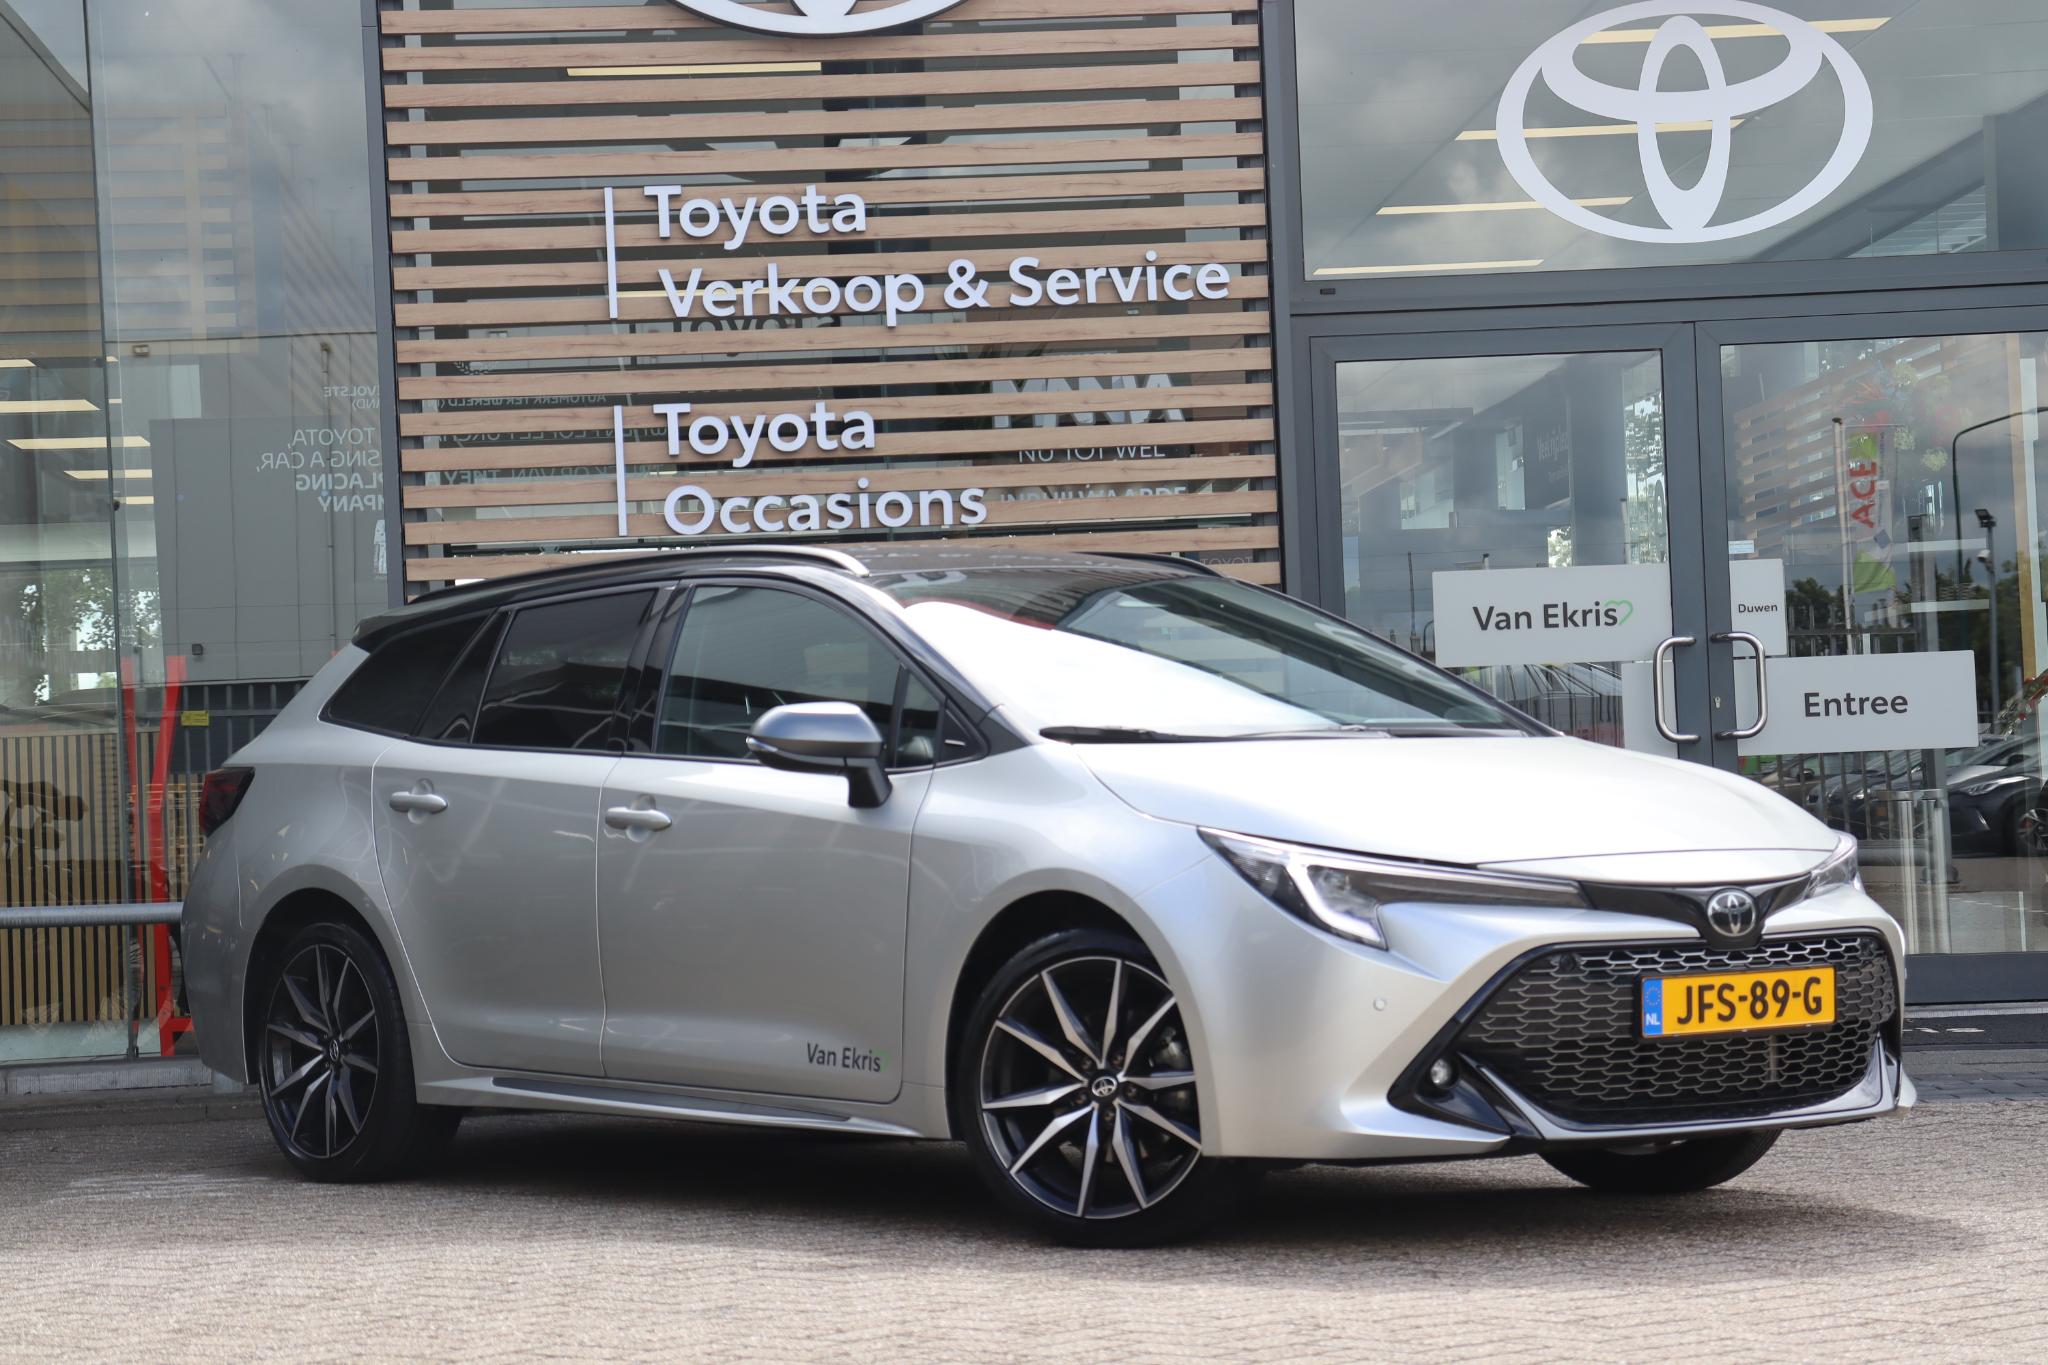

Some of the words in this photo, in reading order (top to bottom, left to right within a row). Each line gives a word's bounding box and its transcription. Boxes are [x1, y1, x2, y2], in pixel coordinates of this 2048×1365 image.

[644, 184, 867, 250] Toyota
[658, 263, 925, 327] Verkoop
[944, 258, 989, 309] &
[1009, 251, 1231, 307] Service
[653, 401, 876, 468] Toyota
[664, 477, 988, 536] Occasions
[1473, 605, 1533, 632] Van
[1542, 601, 1619, 629] Ekris
[1738, 603, 1778, 613] Duwen
[1803, 690, 1909, 718] Entree
[1646, 1013, 1660, 1025] NL
[1677, 977, 1822, 1024] JFS-89-G
[807, 1043, 836, 1065] Van
[841, 1046, 881, 1073] Ekris
